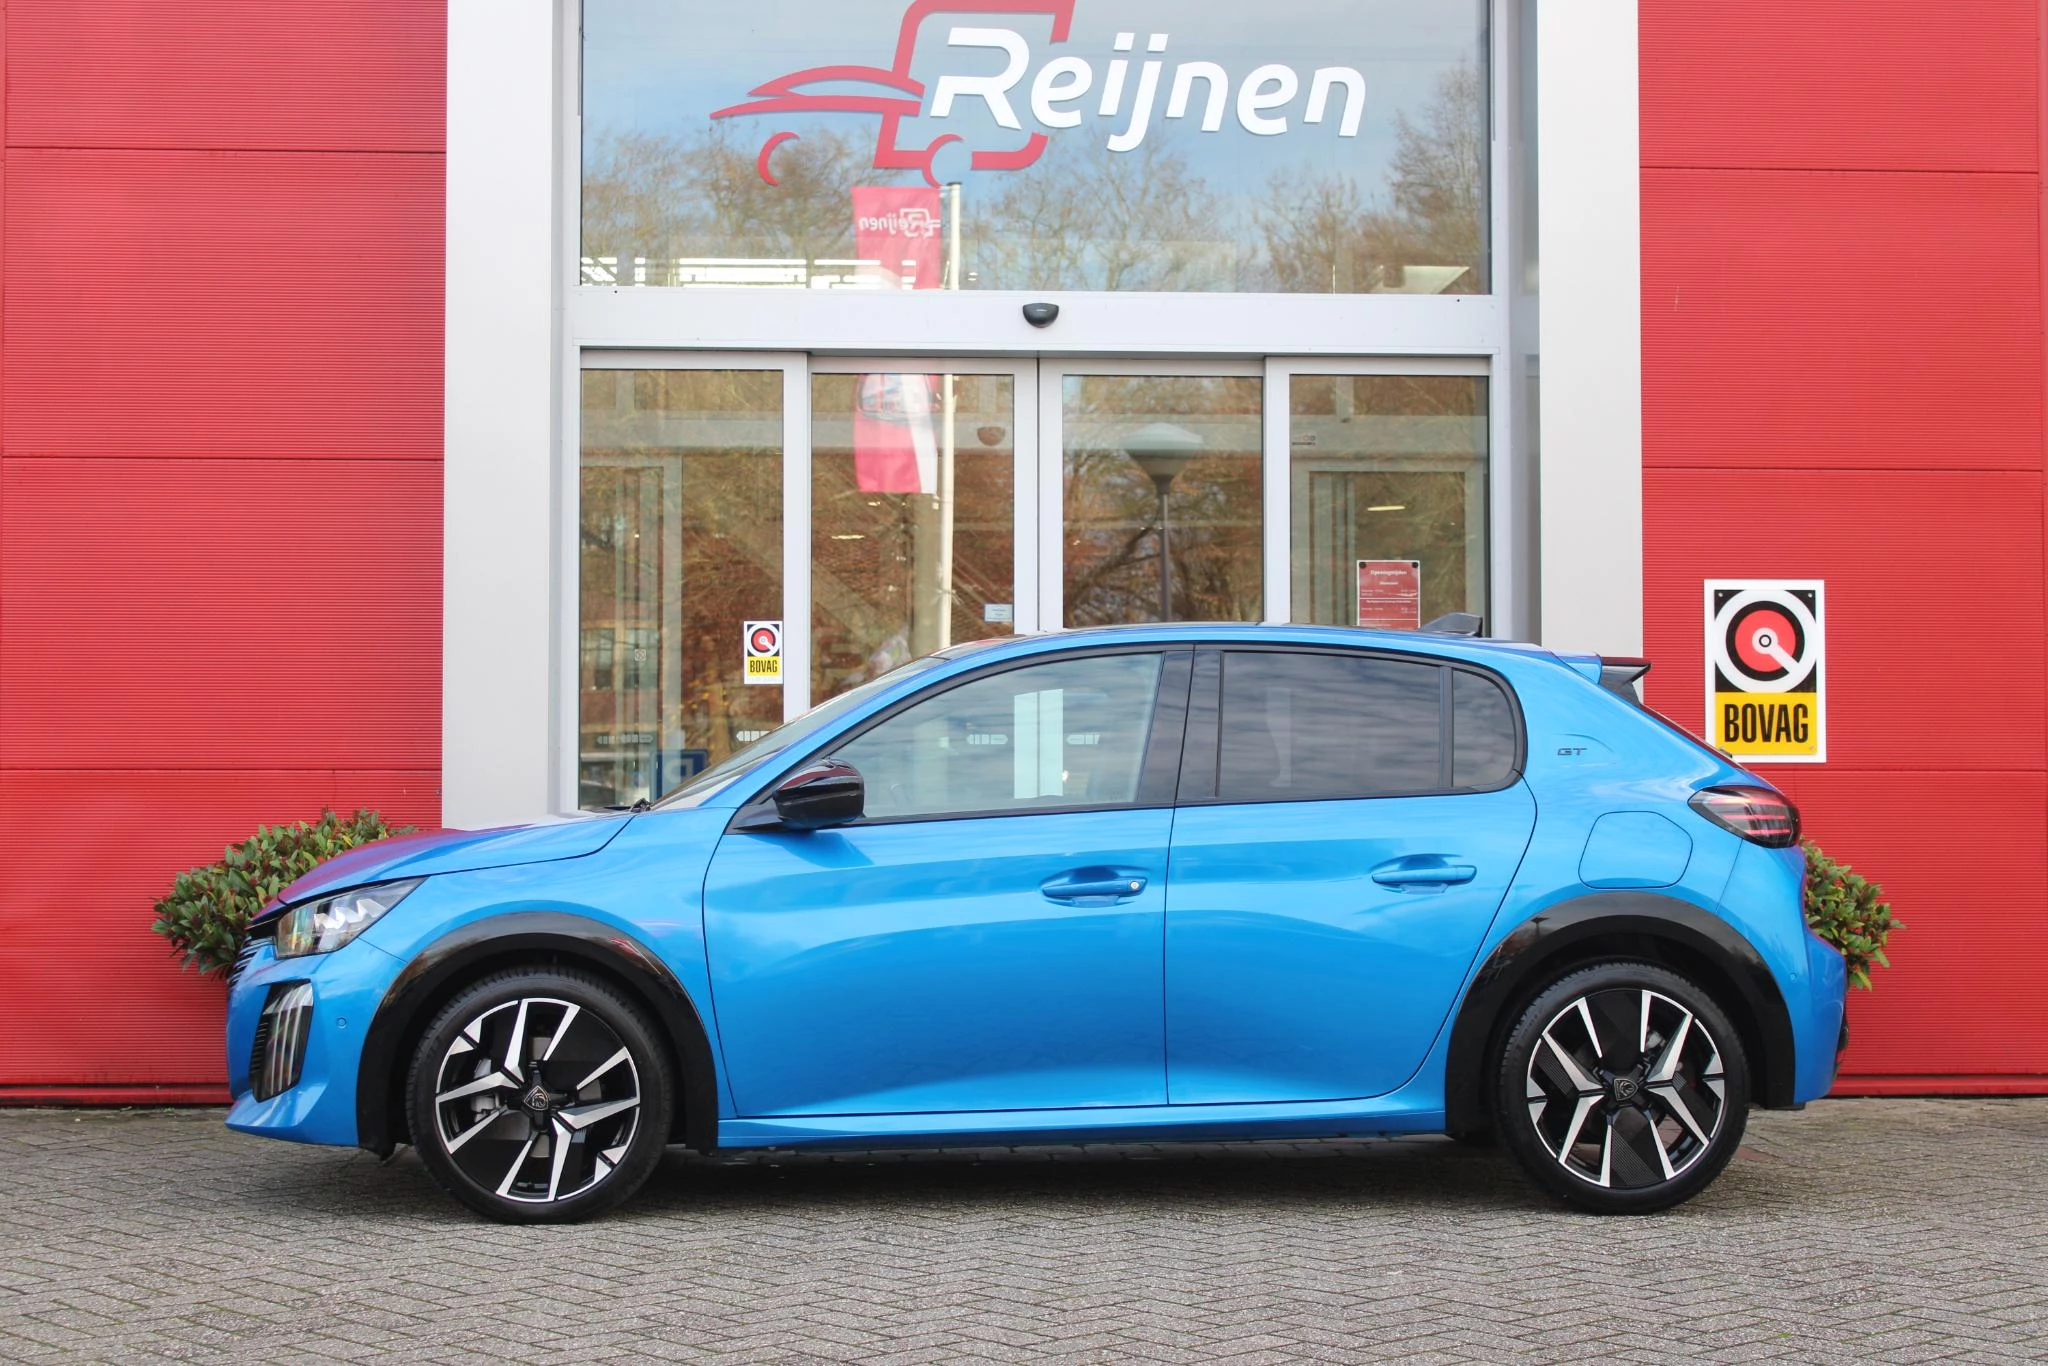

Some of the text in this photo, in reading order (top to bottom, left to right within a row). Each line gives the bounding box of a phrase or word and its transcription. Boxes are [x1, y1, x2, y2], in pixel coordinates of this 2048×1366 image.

[929, 27, 1366, 152] Reijnen
[749, 660, 778, 673] BOVAG
[1724, 703, 1809, 743] BOVAG
[1557, 747, 1588, 756] GT
